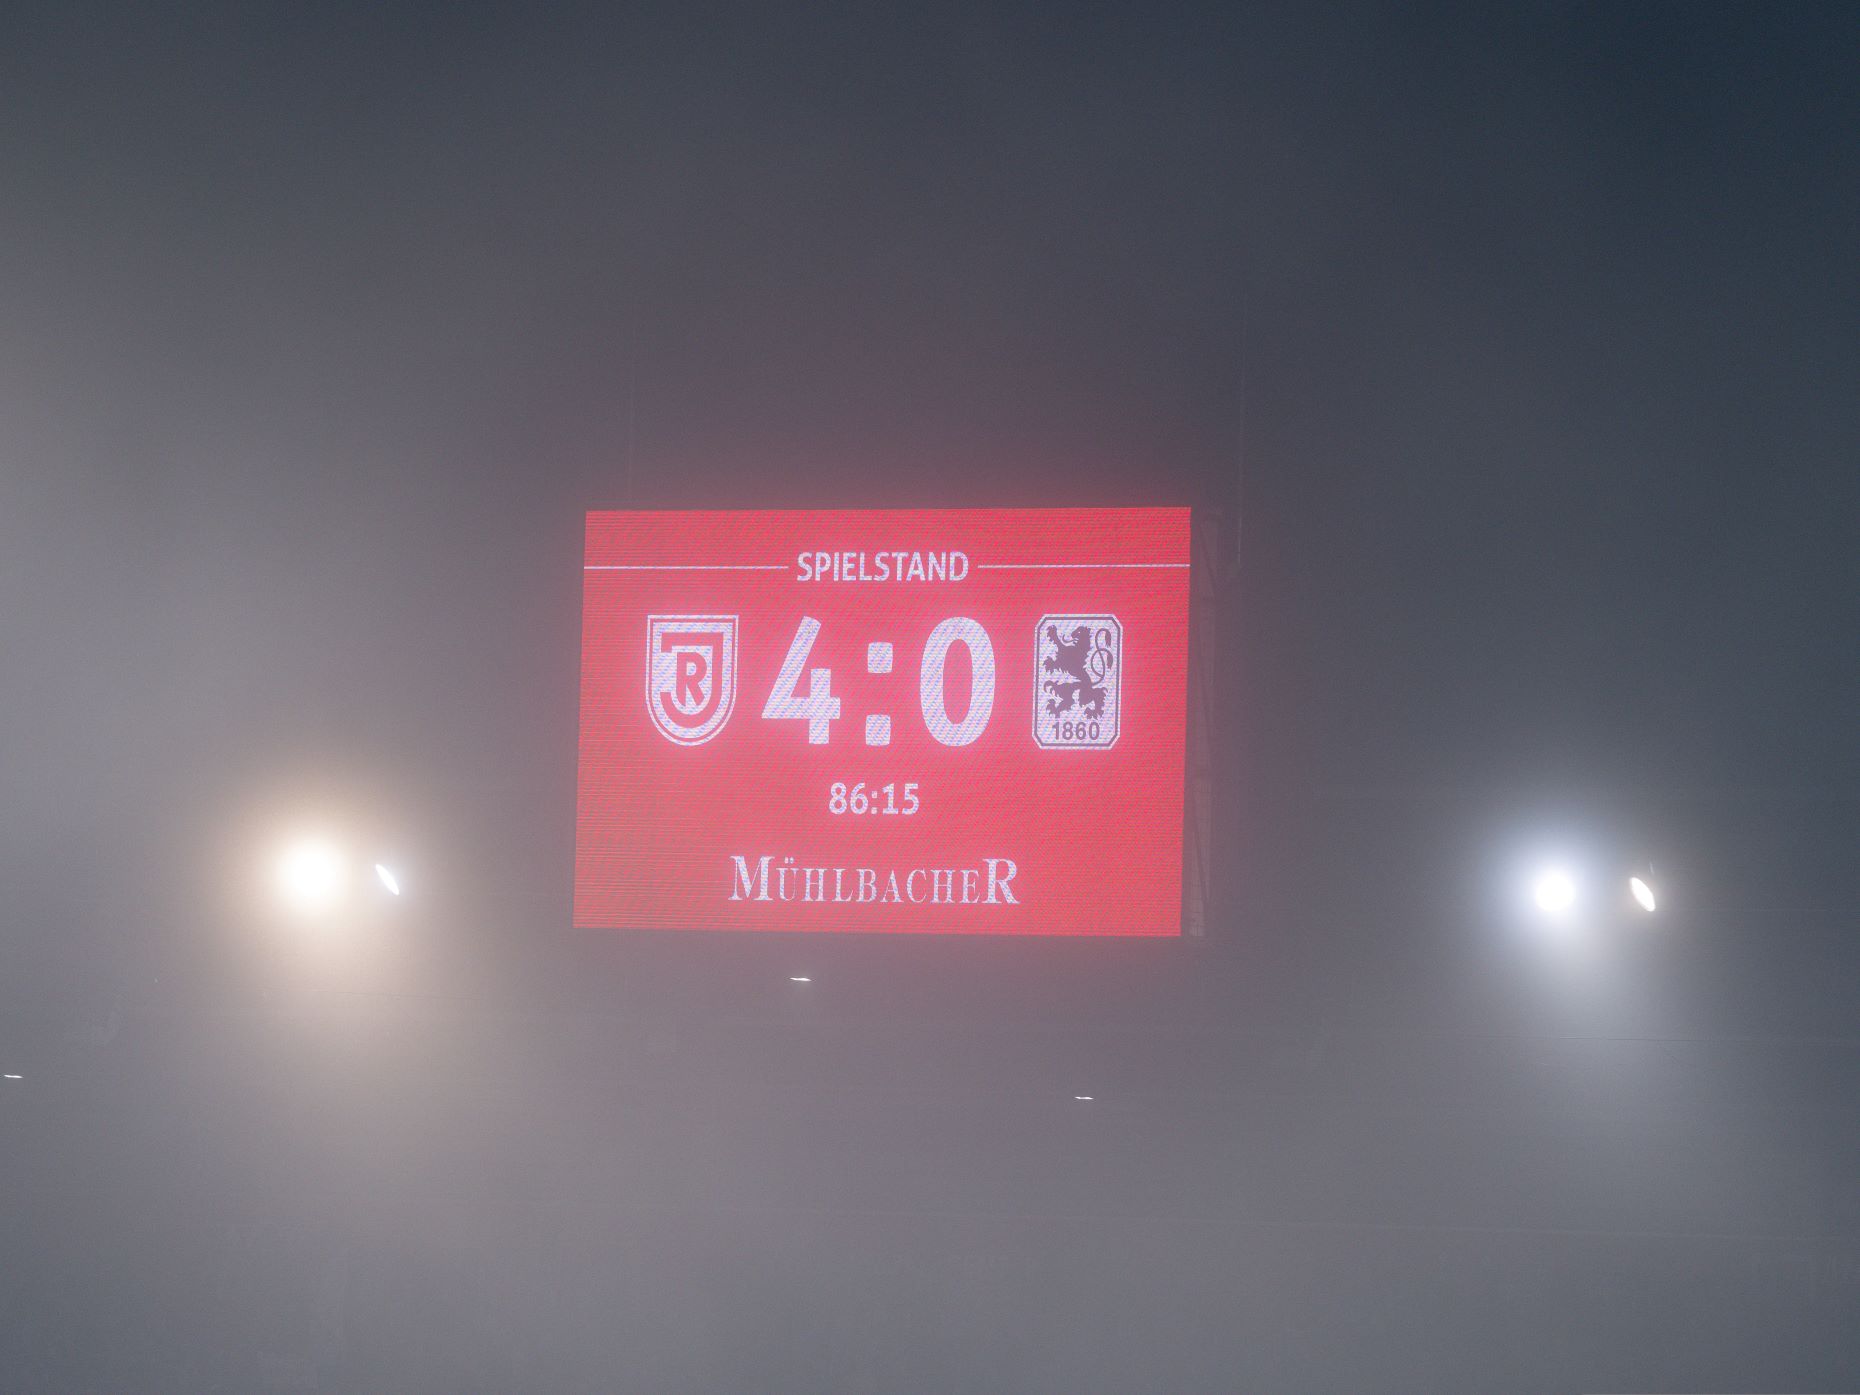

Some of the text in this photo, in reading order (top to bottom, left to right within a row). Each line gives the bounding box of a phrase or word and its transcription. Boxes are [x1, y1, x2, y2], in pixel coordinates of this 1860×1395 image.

[796, 551, 969, 582] SPIELSTAND
[1052, 721, 1101, 741] 1860
[828, 782, 920, 815] 86:15
[727, 855, 1021, 905] MÜHLBACHER
